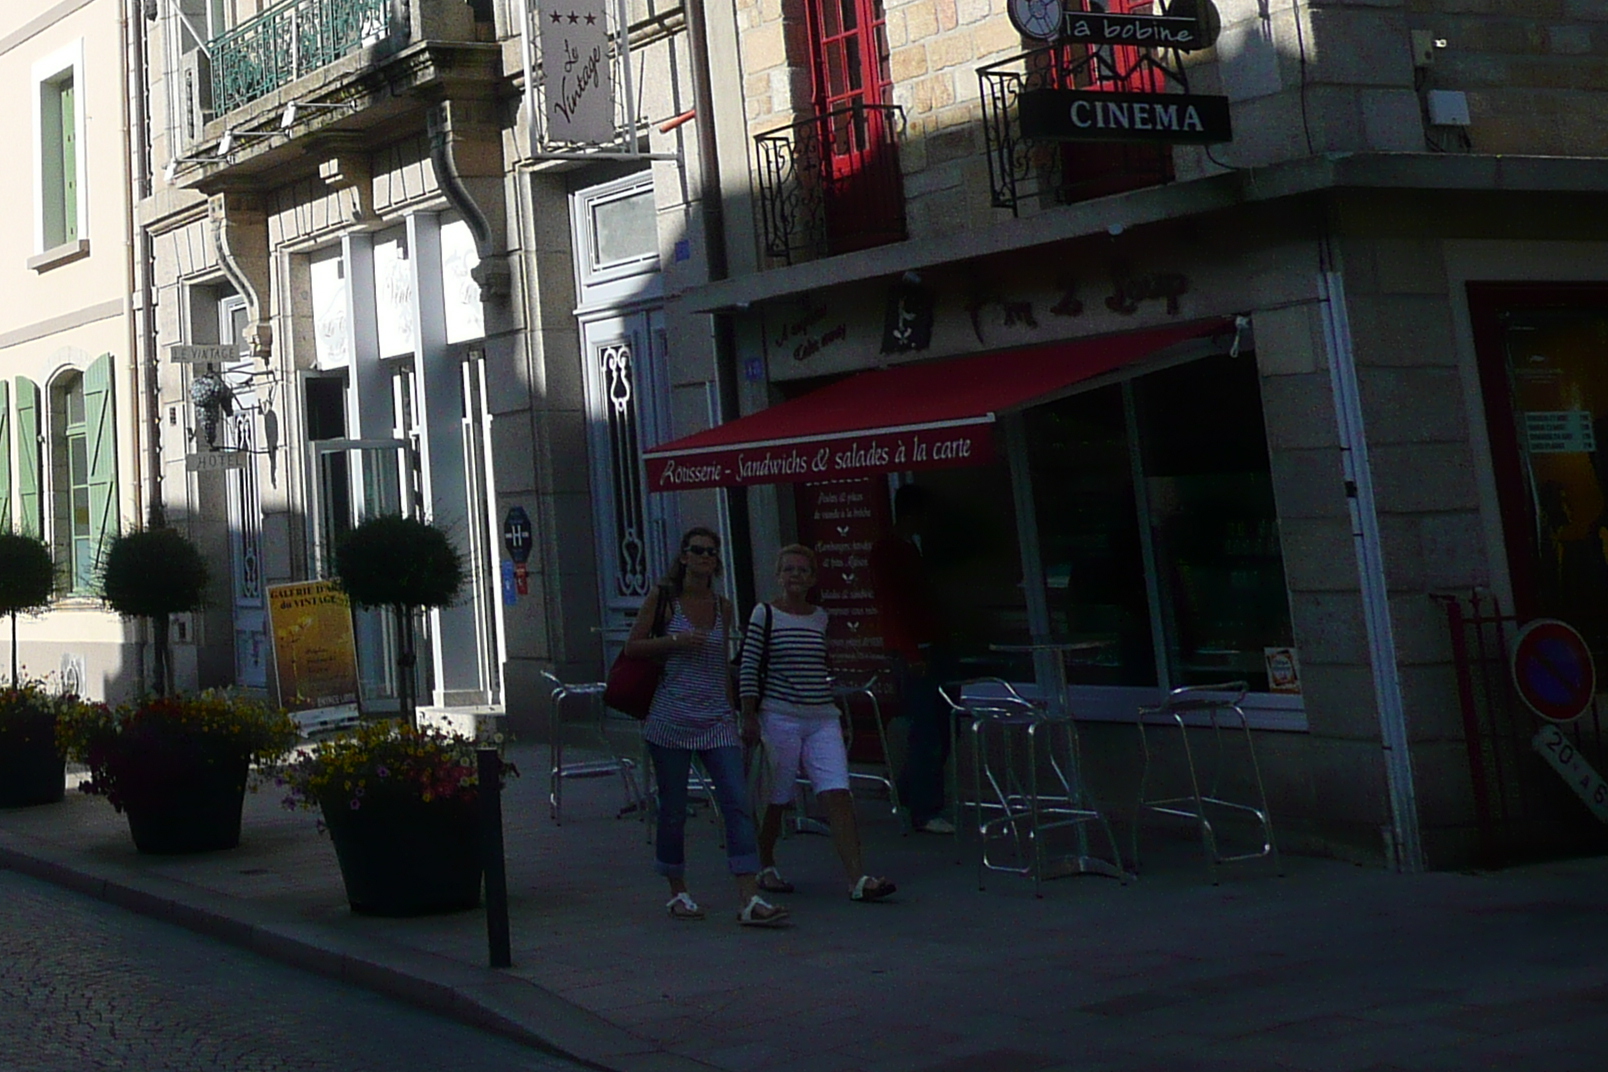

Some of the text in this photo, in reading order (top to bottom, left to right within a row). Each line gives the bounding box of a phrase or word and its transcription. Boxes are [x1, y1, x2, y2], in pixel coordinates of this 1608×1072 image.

[1065, 15, 1194, 43] la bobine
[554, 44, 602, 124] Vintage
[1070, 100, 1205, 132] CINEMA
[191, 347, 235, 360] VINTAGE
[197, 454, 242, 469] HOTEL
[736, 453, 807, 481] Sandwichs
[812, 447, 829, 472] &
[835, 441, 889, 469] salades
[895, 439, 906, 463] à
[913, 435, 927, 460] la
[933, 437, 971, 460] carte
[511, 524, 522, 547] H
[271, 586, 311, 600] GALERIE
[294, 594, 336, 609] VINTAGE
